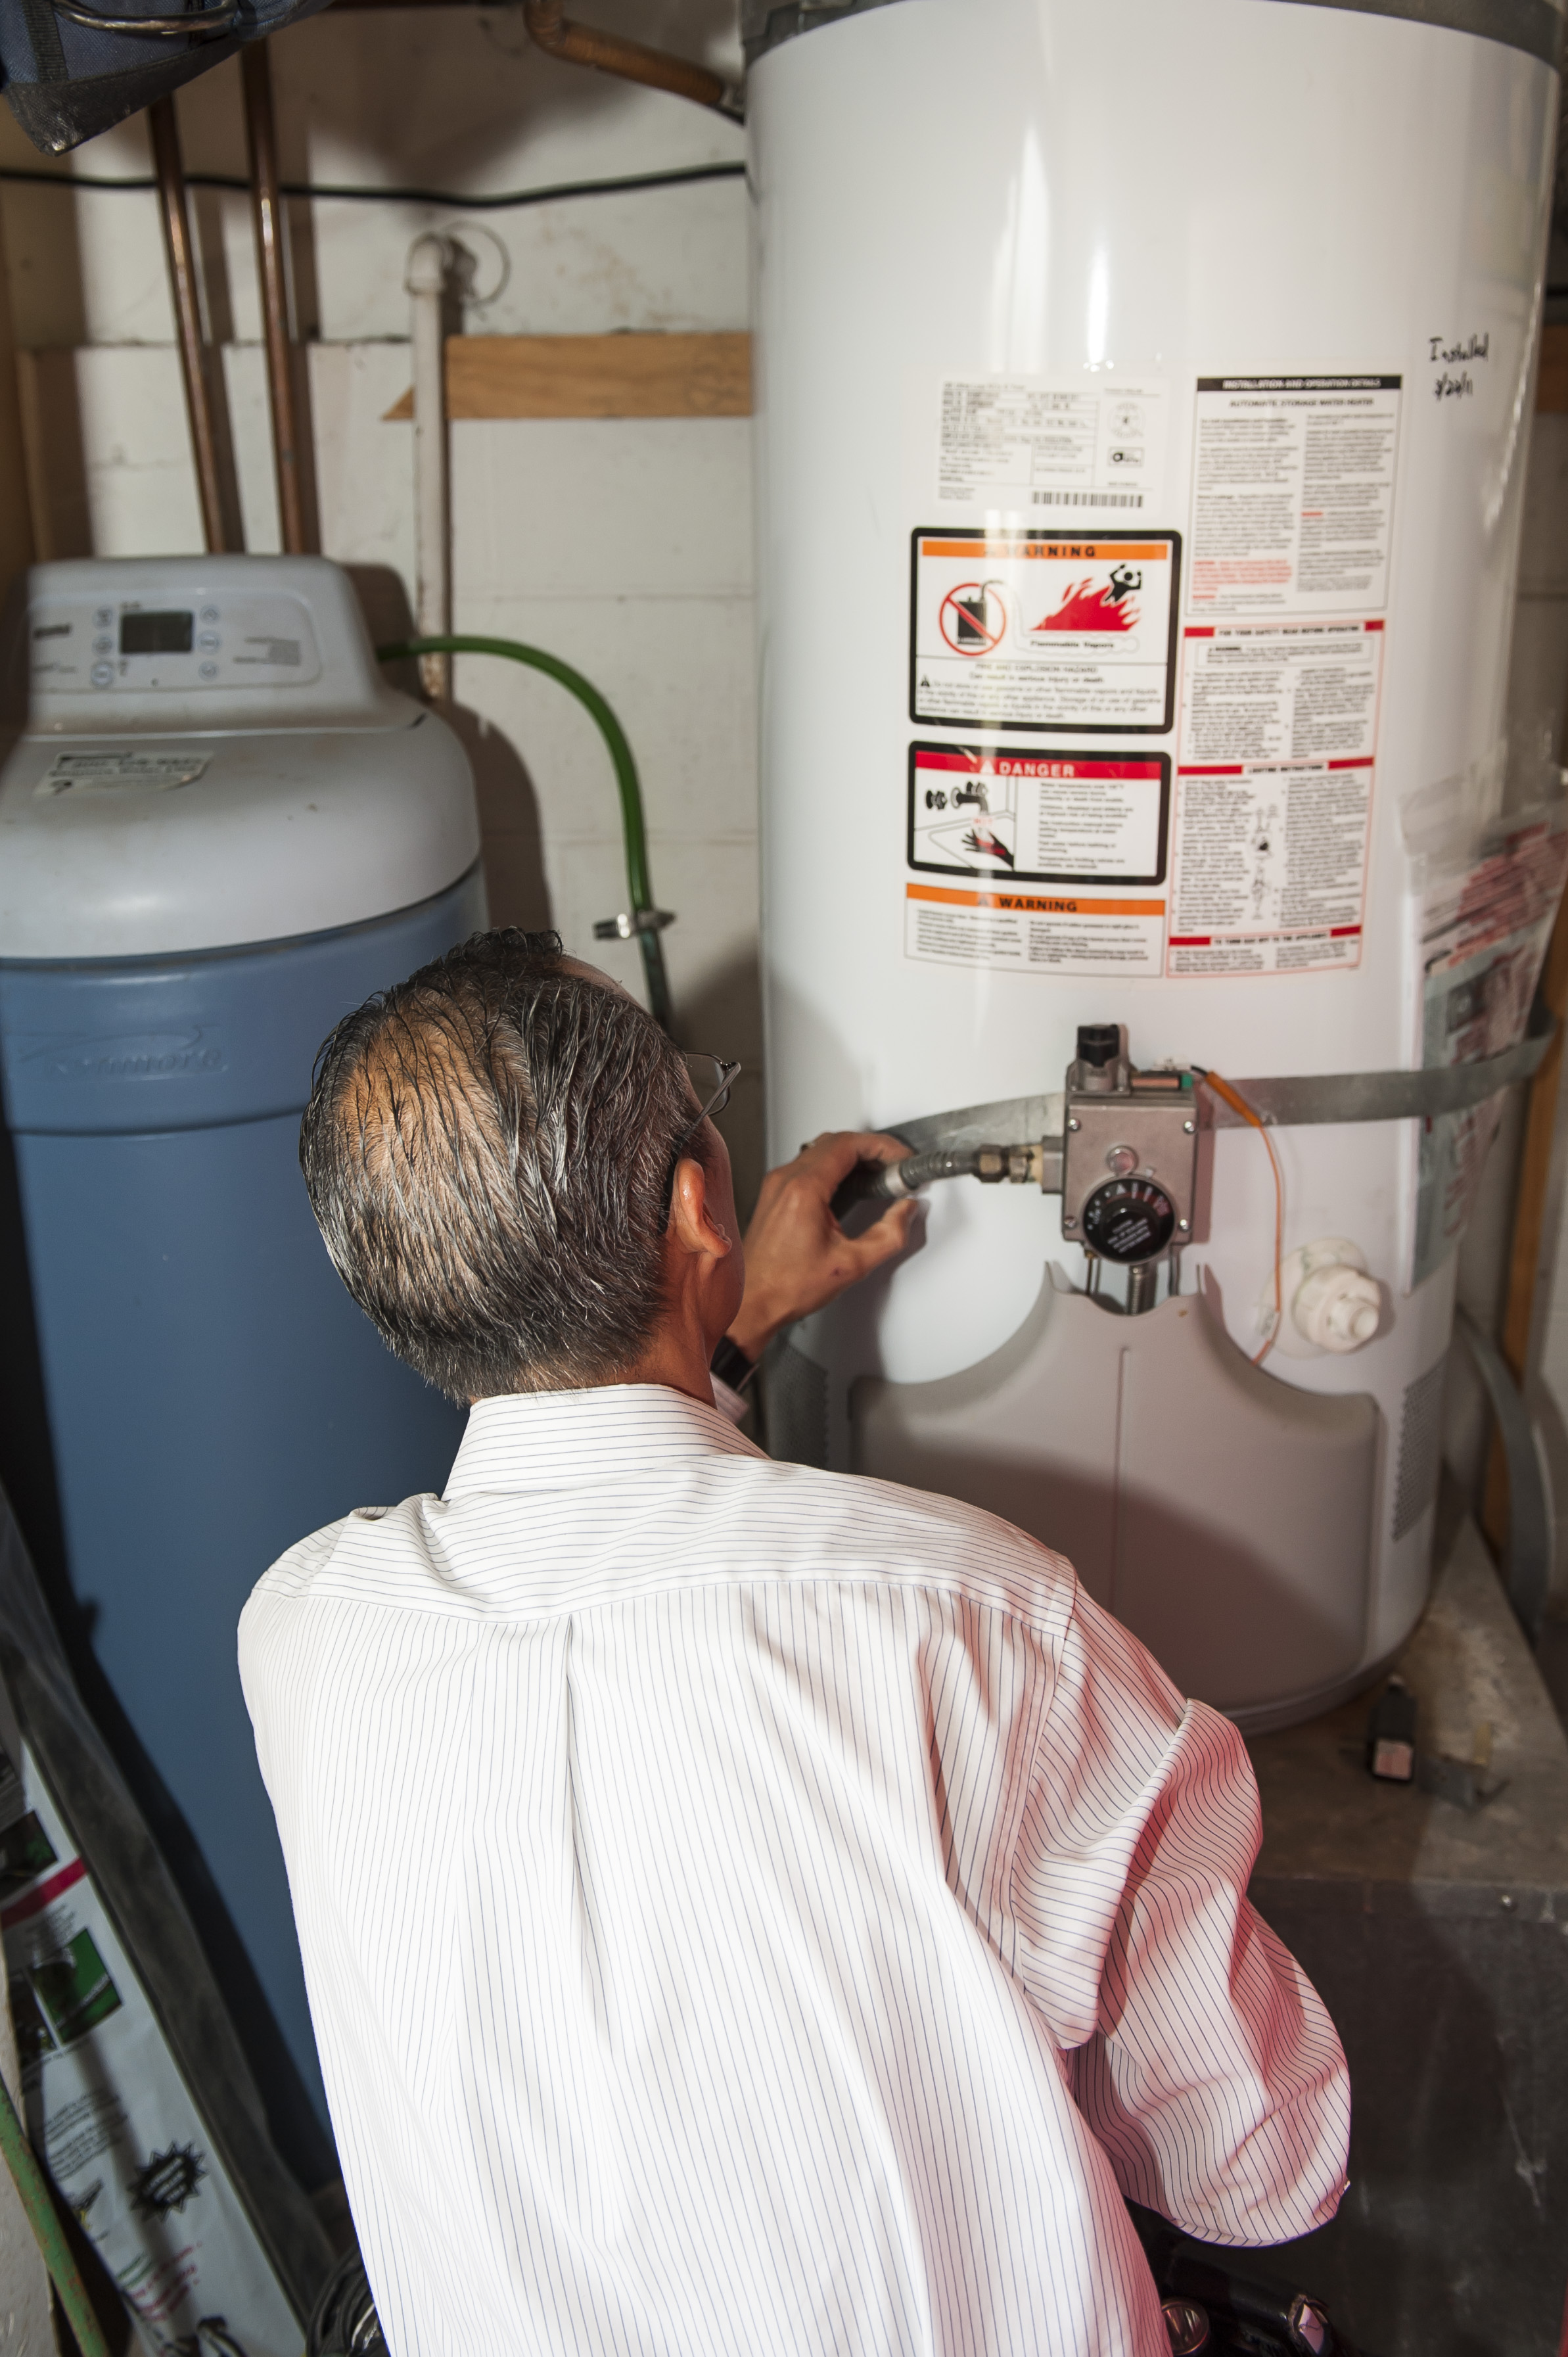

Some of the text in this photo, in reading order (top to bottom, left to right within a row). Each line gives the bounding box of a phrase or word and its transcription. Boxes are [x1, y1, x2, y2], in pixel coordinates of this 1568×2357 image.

[1007, 545, 1095, 557] ARNING
[999, 761, 1074, 778] DANGER
[1000, 897, 1078, 912] WARNING
